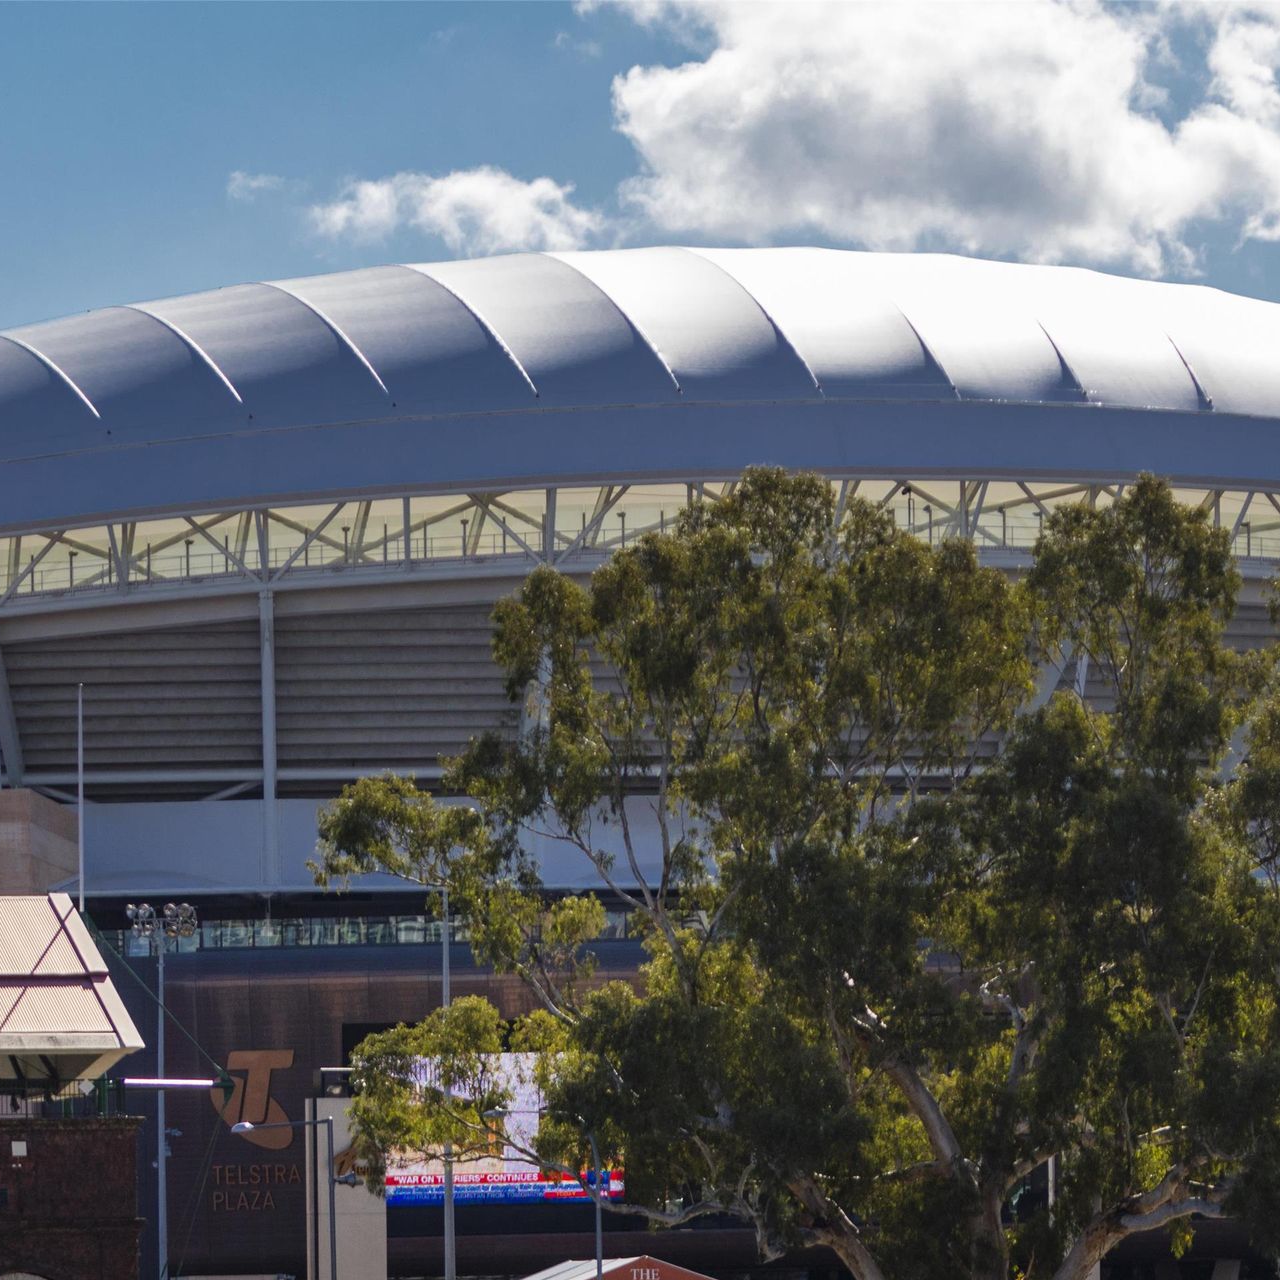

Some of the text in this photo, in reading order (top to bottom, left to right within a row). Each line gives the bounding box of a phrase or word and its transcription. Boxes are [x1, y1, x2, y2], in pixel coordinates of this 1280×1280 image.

[212, 1165, 302, 1184] TELSTRA
[421, 1175, 434, 1184] ON
[486, 1173, 539, 1182] CONTINUES
[212, 1191, 276, 1211] PLAZA
[631, 1268, 660, 1280] THE
